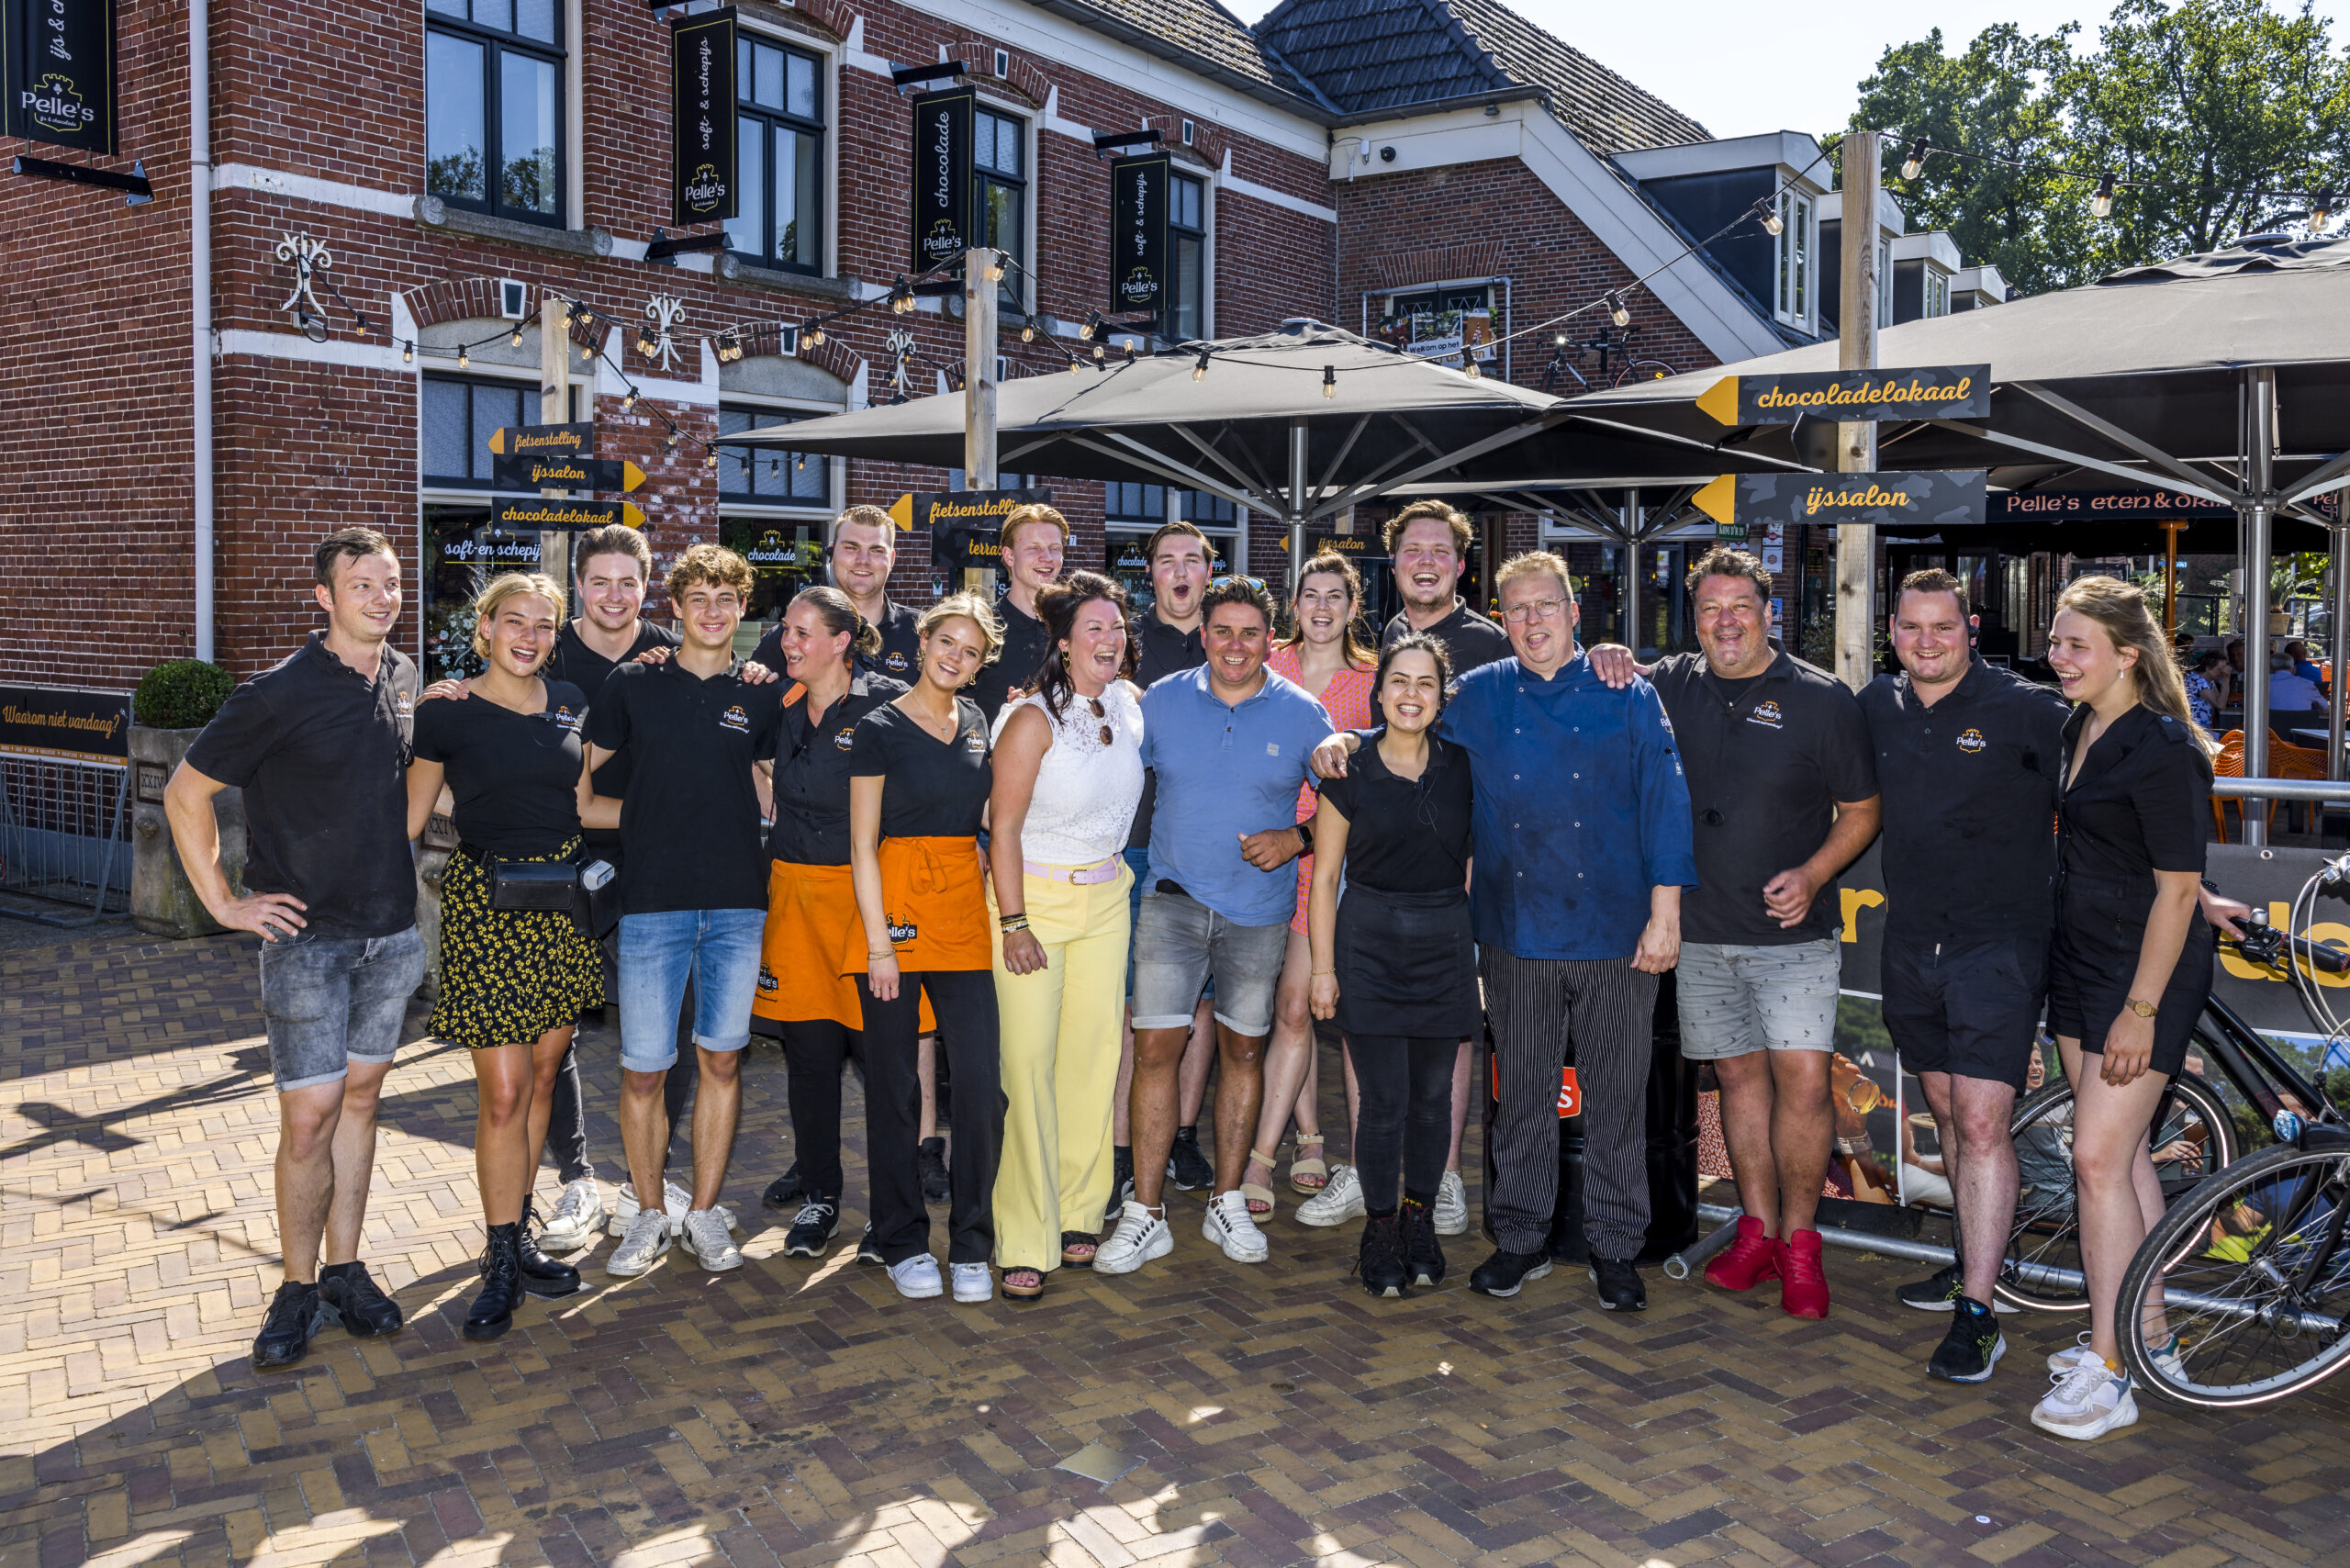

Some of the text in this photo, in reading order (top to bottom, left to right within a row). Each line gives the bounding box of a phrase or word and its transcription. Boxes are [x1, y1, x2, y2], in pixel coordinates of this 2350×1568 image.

[48, 18, 64, 31] &
[50, 35, 72, 61] ijs
[699, 37, 712, 150] soft- & schepijs
[22, 91, 95, 122] Pelle's
[934, 111, 949, 207] chocolade
[685, 183, 725, 202] Pelle's
[1135, 172, 1147, 256] soft- & schepijs
[923, 235, 961, 251] Pelle's
[1122, 281, 1158, 294] Pelle's
[1410, 345, 1437, 353] Welkom
[1757, 377, 1971, 408] chocoladelokaal
[514, 431, 582, 453] fietsenstalling
[532, 465, 587, 482] ijssalon
[1807, 485, 1910, 515] ijssalon
[2007, 495, 2080, 512] Pelle's
[2091, 496, 2151, 510] eten
[502, 507, 613, 524] chocoladelokaal
[497, 541, 542, 561] schepij
[1317, 537, 1366, 553] ijssalon
[748, 547, 796, 561] chocolade
[1117, 555, 1147, 566] chocolade
[1753, 706, 1782, 720] Pelle's
[2, 705, 120, 740] Waarom niet vandaag?
[1956, 736, 1986, 747] Pelle's
[140, 773, 164, 790] XXIV
[889, 926, 916, 937] lle's
[758, 975, 778, 989] elle's
